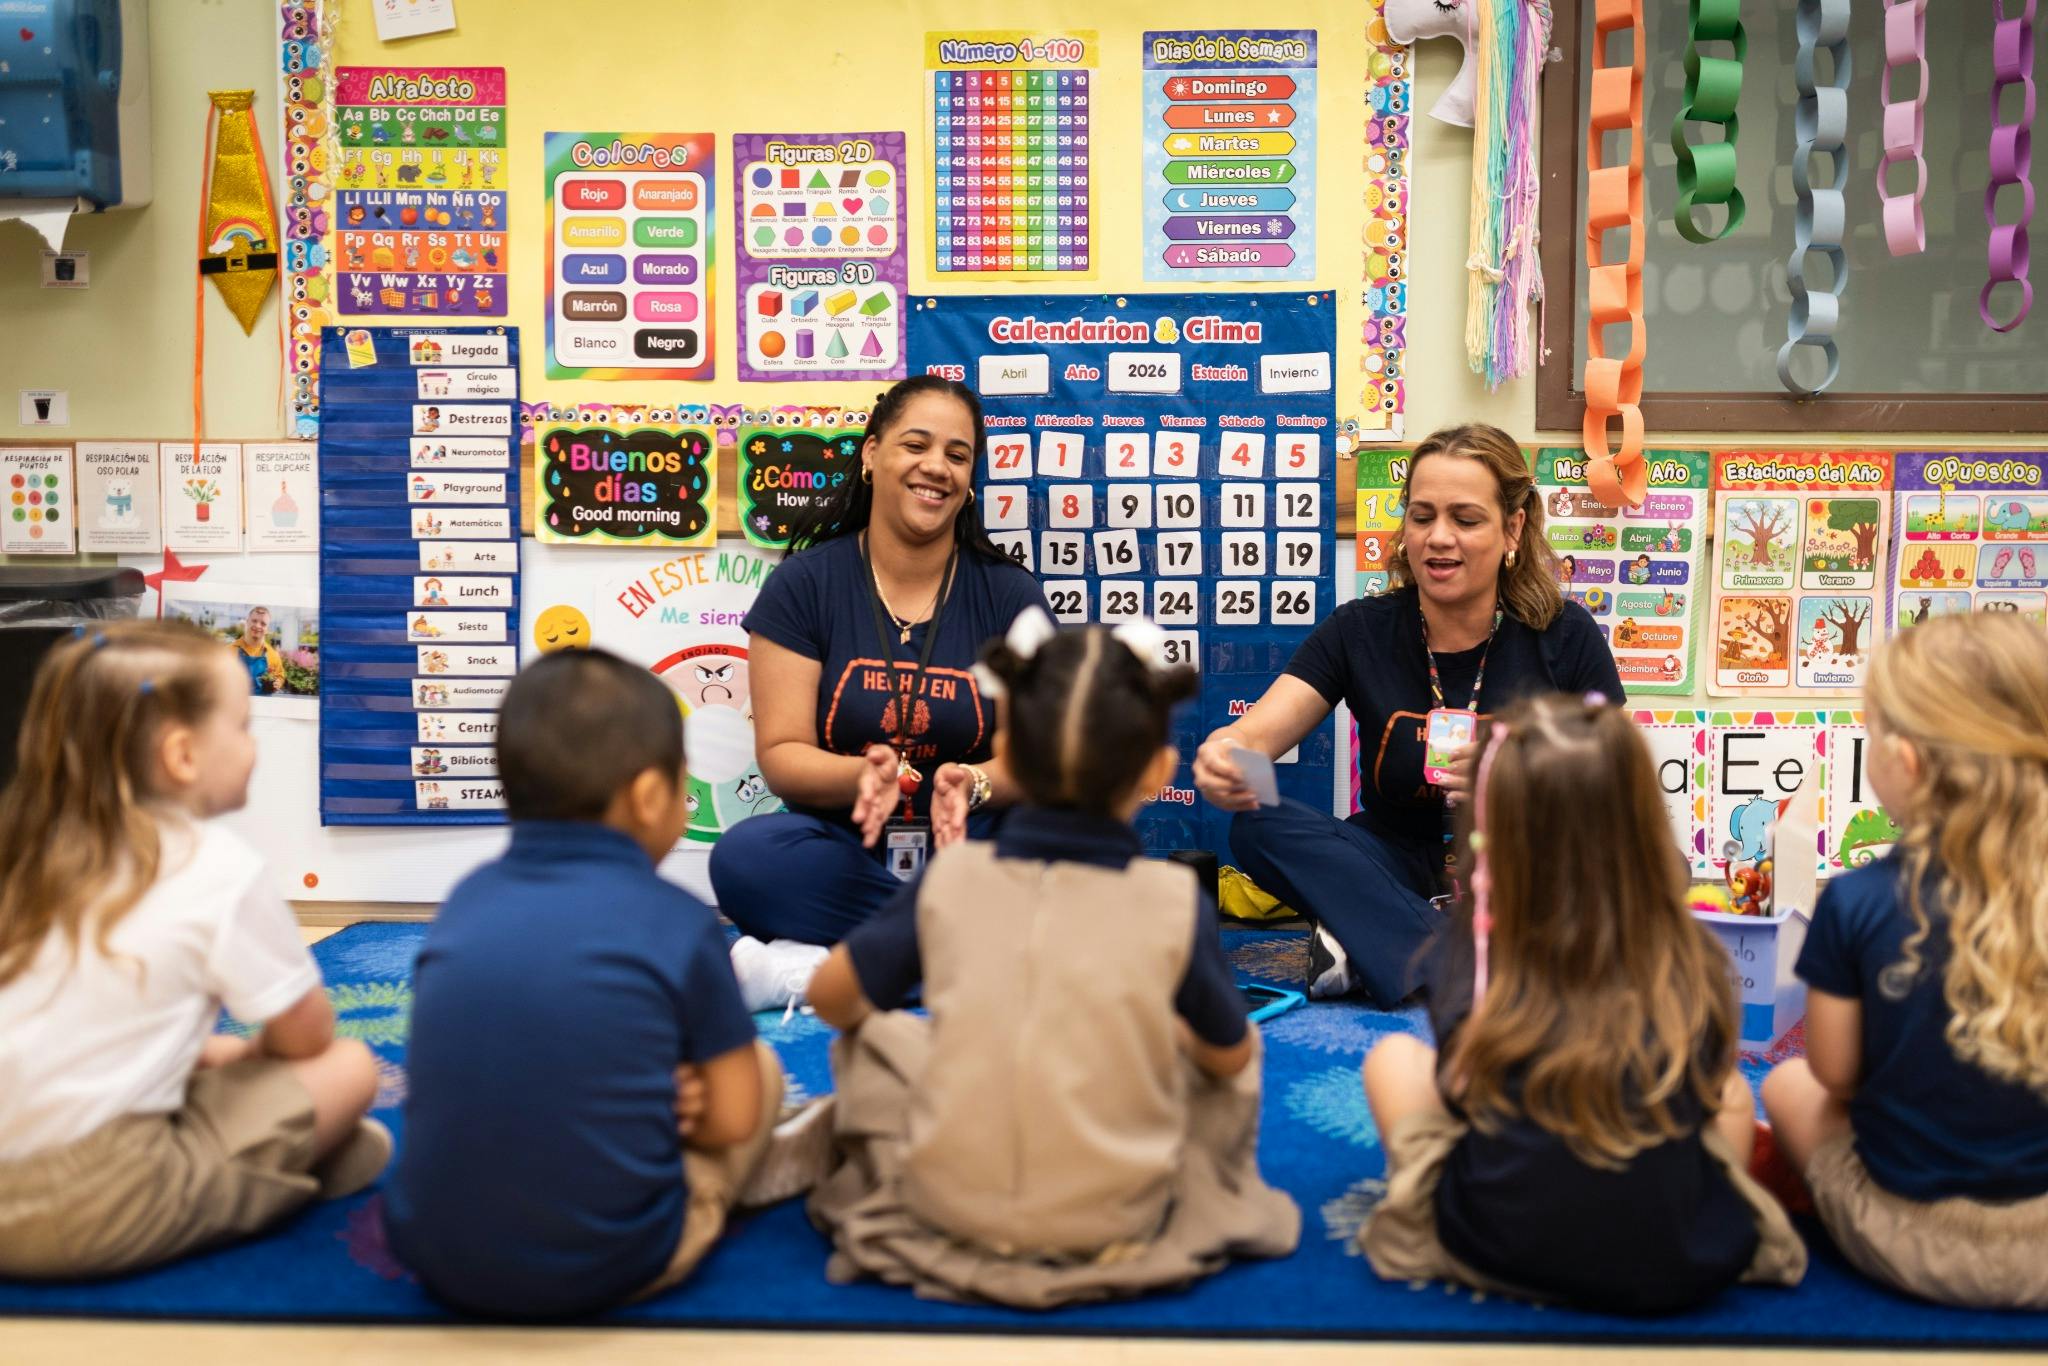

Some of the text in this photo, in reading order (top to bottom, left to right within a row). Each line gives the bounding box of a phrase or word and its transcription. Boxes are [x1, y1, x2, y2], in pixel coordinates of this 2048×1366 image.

[941, 41, 1016, 61] Número
[1156, 39, 1304, 61] Días de la Semana
[370, 76, 473, 100] Alfabeto
[1192, 80, 1268, 97] Domingo
[952, 97, 965, 106] 12
[1028, 97, 1041, 106] 17
[1059, 96, 1071, 106] 19
[1074, 96, 1087, 105] 20
[343, 109, 499, 121] Aa Bb Cc Chch Dd Ee
[1203, 109, 1255, 123] Lunes
[1199, 137, 1259, 151] Martes
[572, 140, 688, 168] Colores
[769, 143, 872, 164] Figuras 2D
[1187, 164, 1271, 179] Miércoles
[581, 188, 608, 202] Rojo
[638, 188, 693, 202] Anaranjado
[1200, 193, 1258, 207] Jueves
[569, 225, 620, 237] Amarillo
[647, 226, 684, 238] Verde
[1196, 220, 1262, 235] Viernes
[1196, 247, 1261, 263] Sábado
[581, 263, 608, 275] Azul
[642, 263, 689, 275] Morado
[771, 264, 874, 287] Figuras 3D
[351, 274, 494, 291] Vv Ww Xx Yy Zz
[572, 300, 617, 312] Marrón
[650, 301, 682, 313] Rosa
[991, 318, 1261, 343] Calendarion & Clima
[574, 337, 616, 348] Blanco
[647, 337, 685, 351] Negro
[452, 345, 498, 357] Llegada
[467, 372, 497, 381] Círculo
[927, 365, 965, 382] MES
[1001, 368, 1028, 379] Abril
[1065, 364, 1100, 380] Año
[1128, 364, 1167, 378] 2026
[1192, 365, 1248, 381] Estación
[1270, 368, 1319, 379] Invierno
[468, 385, 500, 395] mágico
[449, 414, 508, 424] Destrezas
[984, 415, 1327, 428] Martes Miércoles Jueves Viernes Sábado Domingo
[85, 453, 150, 463] RESPIRACIÓN DEL
[175, 453, 227, 463] RESPACIÓN
[255, 452, 311, 461] RESPIRACIÓN
[451, 448, 507, 456] Neuromotor
[570, 444, 681, 472] Buenos
[994, 442, 1305, 468] 27 1 2 3 4 5
[97, 467, 140, 475] OSO POLAR
[181, 465, 222, 474] DE LA FLOR
[256, 464, 310, 472] DEL CUPCAKE
[1651, 462, 1688, 482] Año
[1725, 463, 1881, 483] Estaciones del Año
[752, 464, 826, 491] ¿Cómo
[443, 483, 503, 494] Playground
[594, 473, 657, 503] días
[776, 492, 809, 507] How
[997, 494, 1313, 519] 7 8 9 10 11 12
[1650, 502, 1685, 510] Febrero
[572, 506, 681, 525] Good morning
[450, 519, 503, 527] Matemáticas
[1365, 520, 1382, 529] Uno
[1552, 533, 1579, 541] Marzo
[1629, 534, 1651, 543] Abril
[474, 552, 496, 561] Arte
[1050, 540, 1313, 566] 15 16 17 18 19
[1364, 561, 1383, 570] Tres
[1587, 567, 1611, 576] Mayo
[1656, 568, 1682, 576] Junio
[617, 580, 656, 619] EN
[650, 553, 709, 598] ESTE
[1734, 576, 1783, 586] Primavera
[1820, 576, 1854, 586] Verano
[460, 586, 499, 597] Lunch
[1050, 591, 1310, 615] 22 23 24 25 26
[1621, 600, 1653, 610] Agosto
[660, 606, 690, 624] Me
[458, 622, 488, 631] Siesta
[1641, 633, 1678, 641] Octubre
[681, 647, 729, 661] ENOJADO
[1164, 640, 1192, 663] 31
[468, 657, 498, 665] Snack
[1737, 672, 1768, 683] Otoño
[1814, 673, 1854, 683] Invierno
[931, 679, 957, 700] EN
[459, 723, 499, 733] Centr
[451, 756, 498, 766] Bibliote
[460, 789, 507, 800] STEAM
[1161, 787, 1194, 805] Hoy
